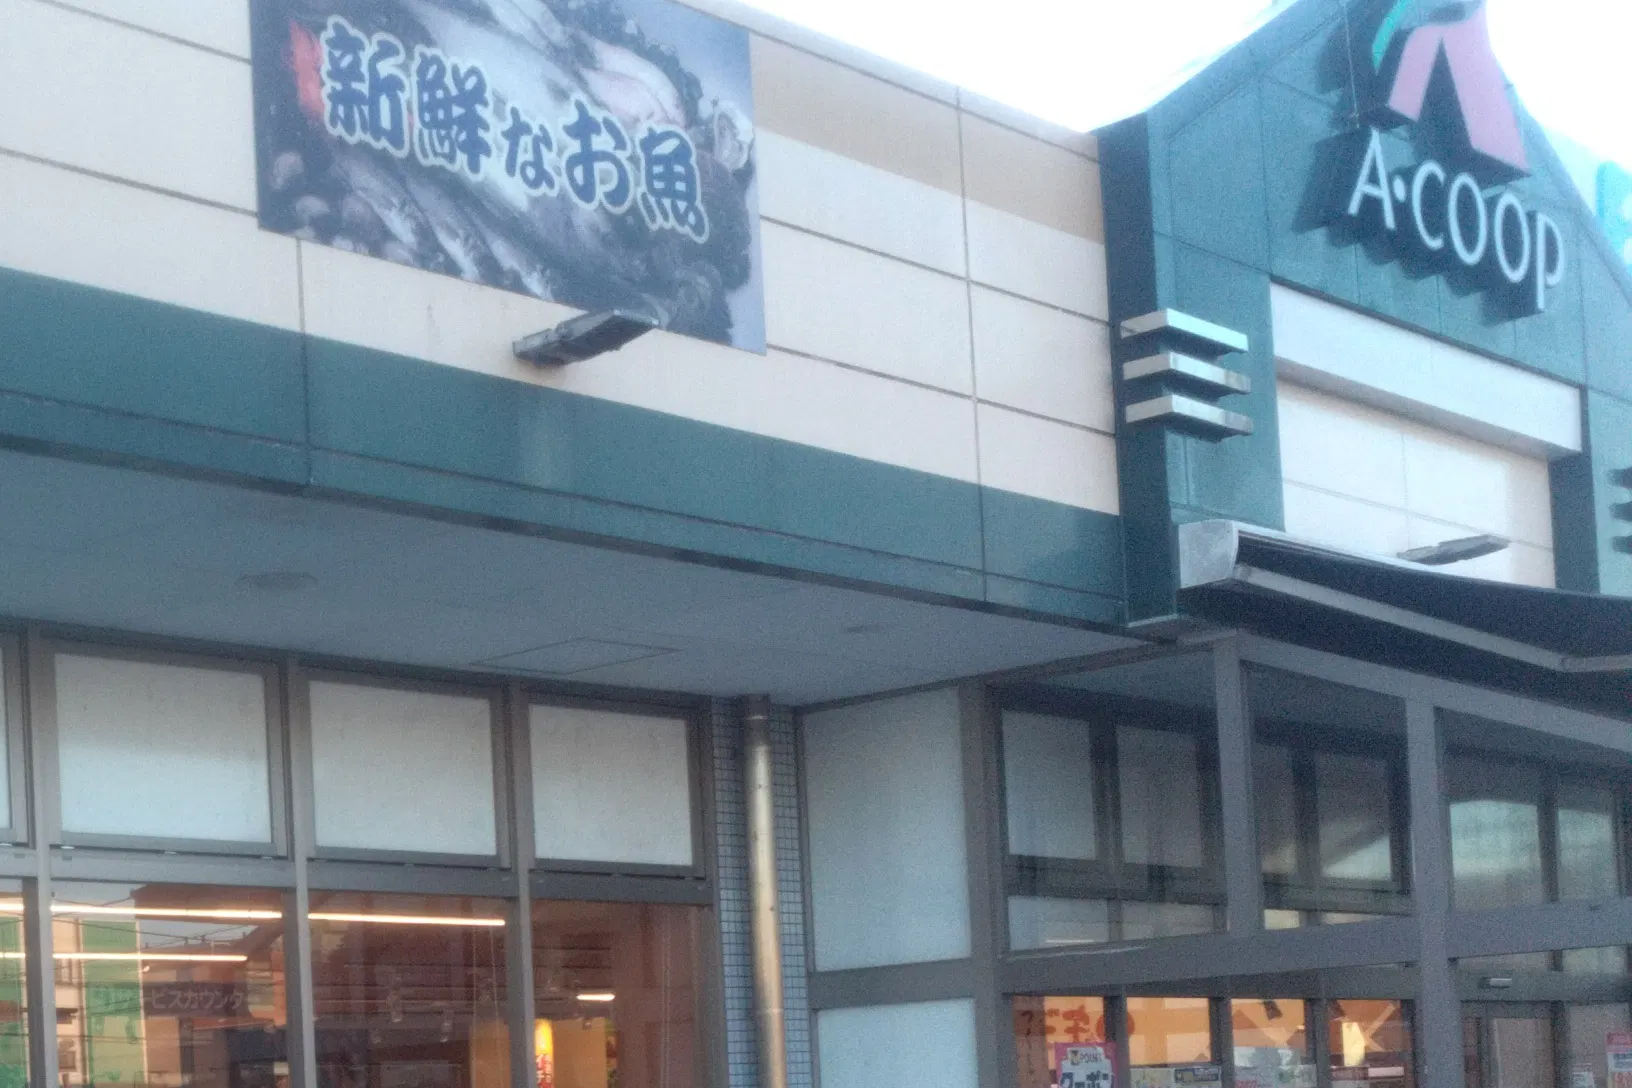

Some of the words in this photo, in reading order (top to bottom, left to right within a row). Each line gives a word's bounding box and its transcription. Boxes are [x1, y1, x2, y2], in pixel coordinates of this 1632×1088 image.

[322, 17, 707, 241] 新鮮なお魚
